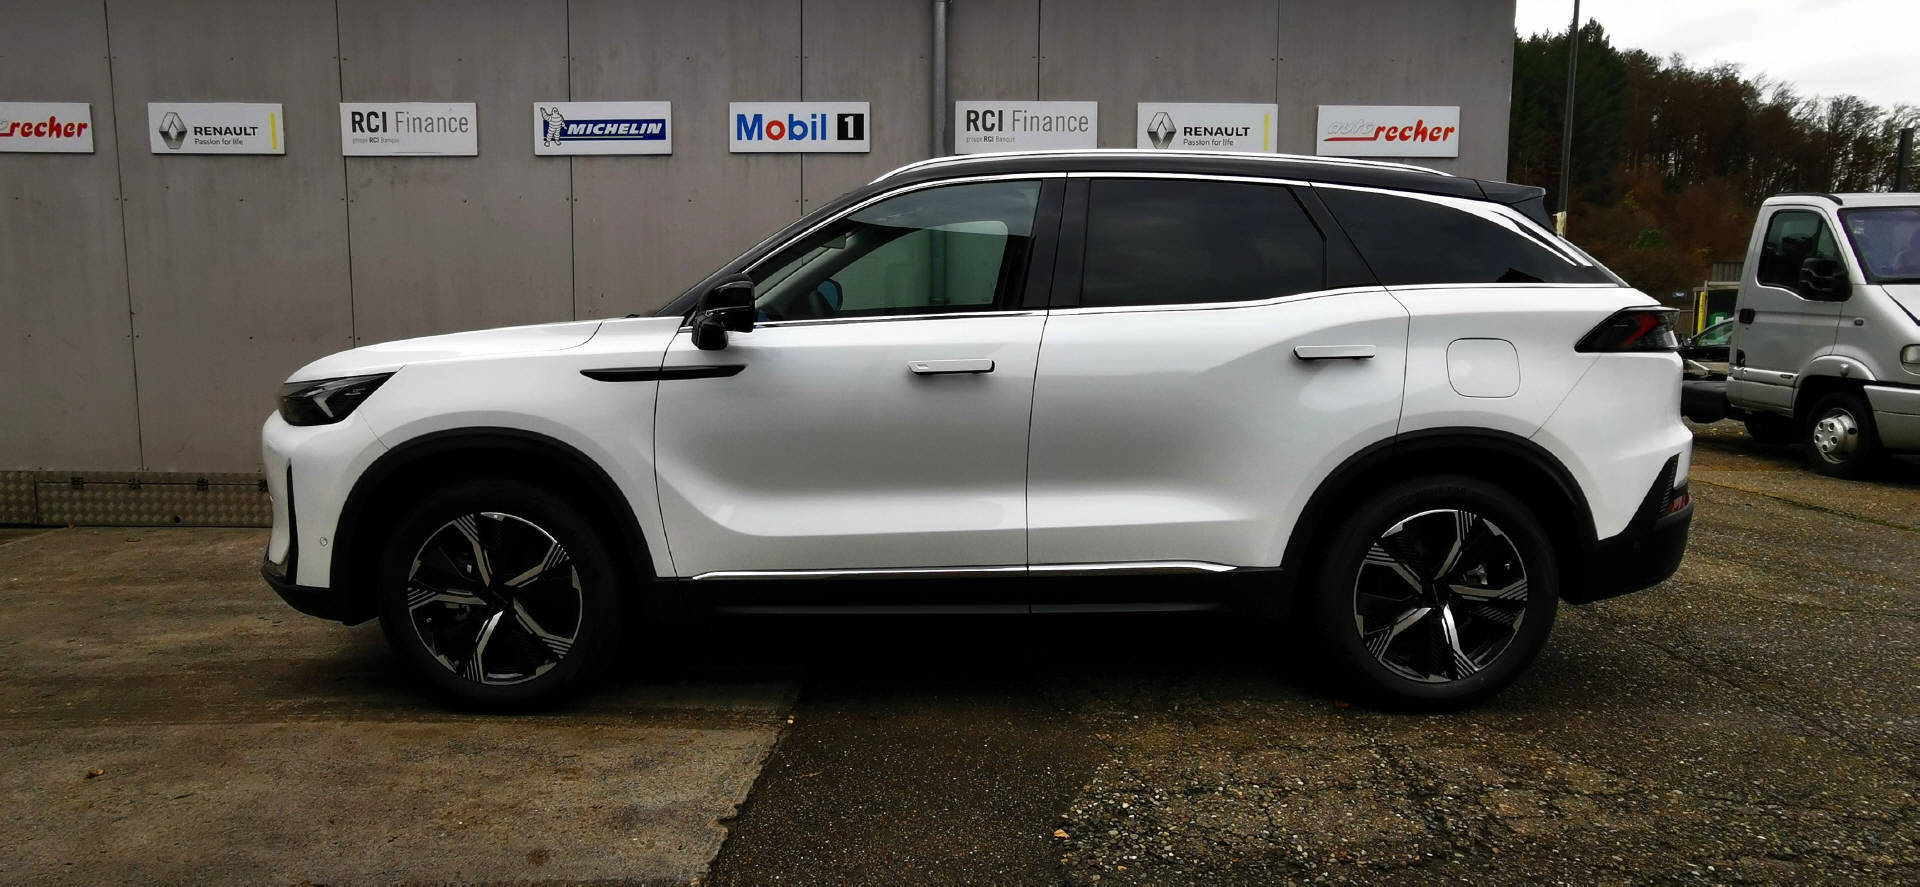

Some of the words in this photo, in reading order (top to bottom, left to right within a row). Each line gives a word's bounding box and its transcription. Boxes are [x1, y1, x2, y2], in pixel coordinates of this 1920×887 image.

[9, 116, 88, 138] recher
[194, 126, 259, 136] RENAULT
[351, 111, 388, 133] RCI
[395, 111, 469, 133] Finance
[567, 123, 663, 135] MICHELIN
[736, 113, 827, 141] Mobil
[966, 109, 1003, 132] RCI
[1012, 109, 1089, 132] Finance
[1183, 126, 1251, 137] RENAULT
[1374, 119, 1456, 142] recher
[1183, 138, 1210, 146] Passion
[1211, 138, 1222, 146] for
[1222, 138, 1234, 146] life
